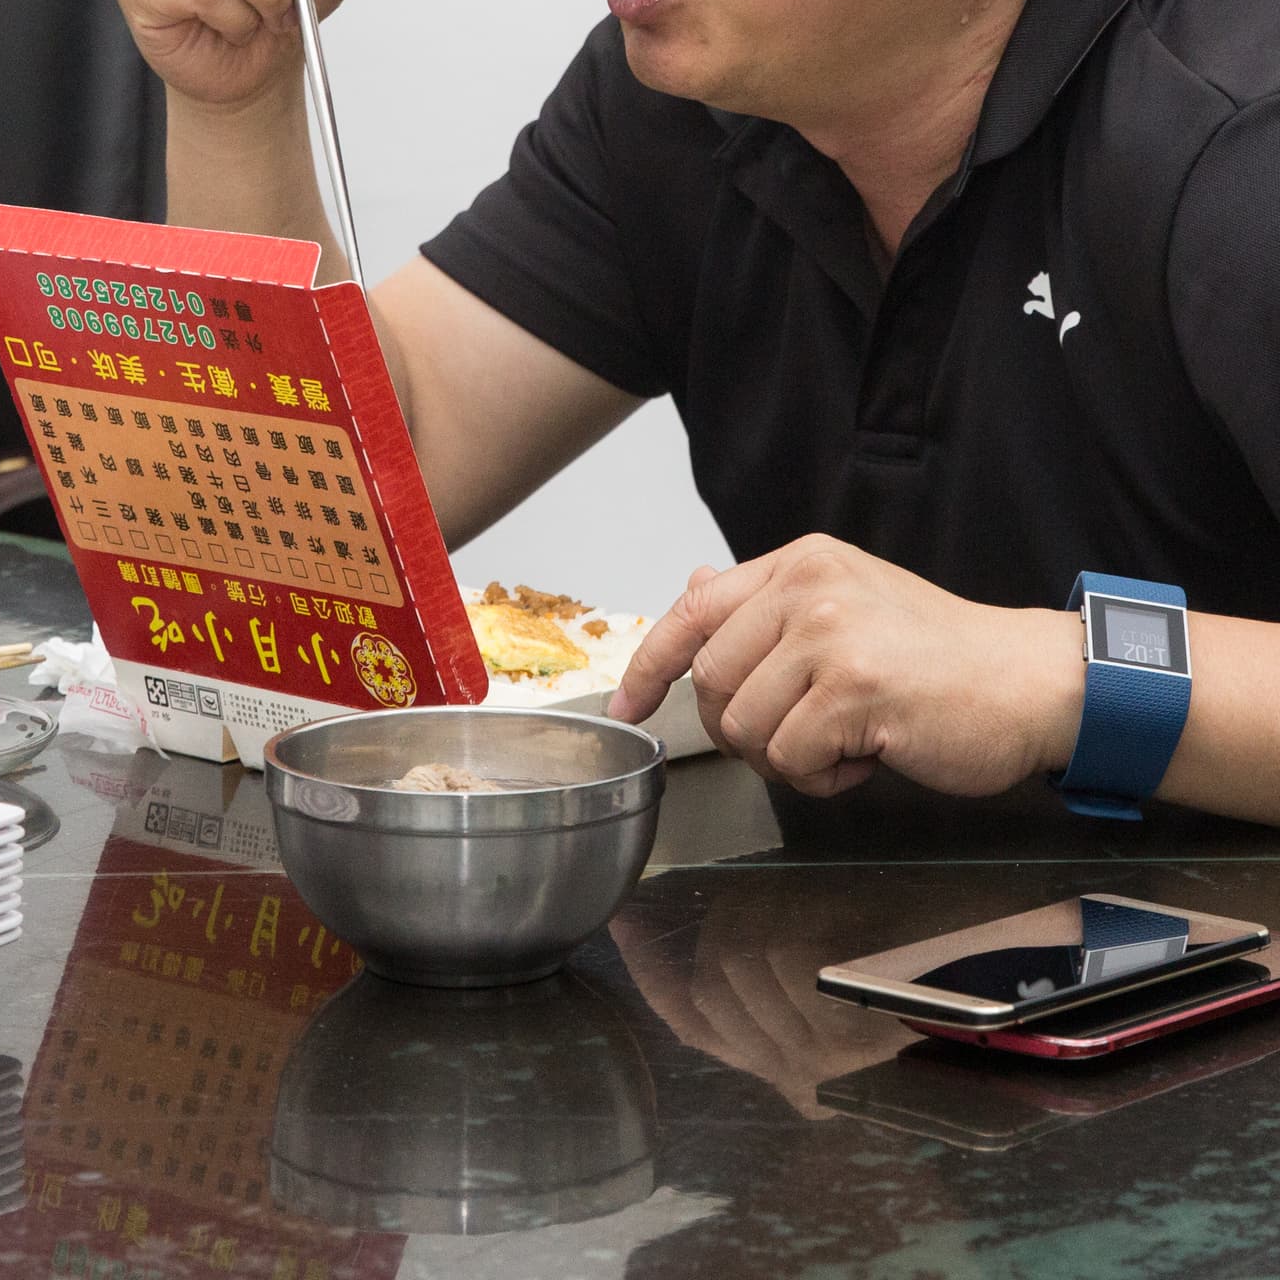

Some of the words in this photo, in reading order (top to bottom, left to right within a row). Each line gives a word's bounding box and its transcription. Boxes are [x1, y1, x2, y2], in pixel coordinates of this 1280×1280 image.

[36, 272, 206, 318] 012525286
[47, 305, 217, 350] 012799908
[219, 328, 264, 354] 外送
[131, 596, 340, 685] 小月小吃
[1124, 643, 1167, 666] 1:02
[1141, 632, 1165, 645] AUG
